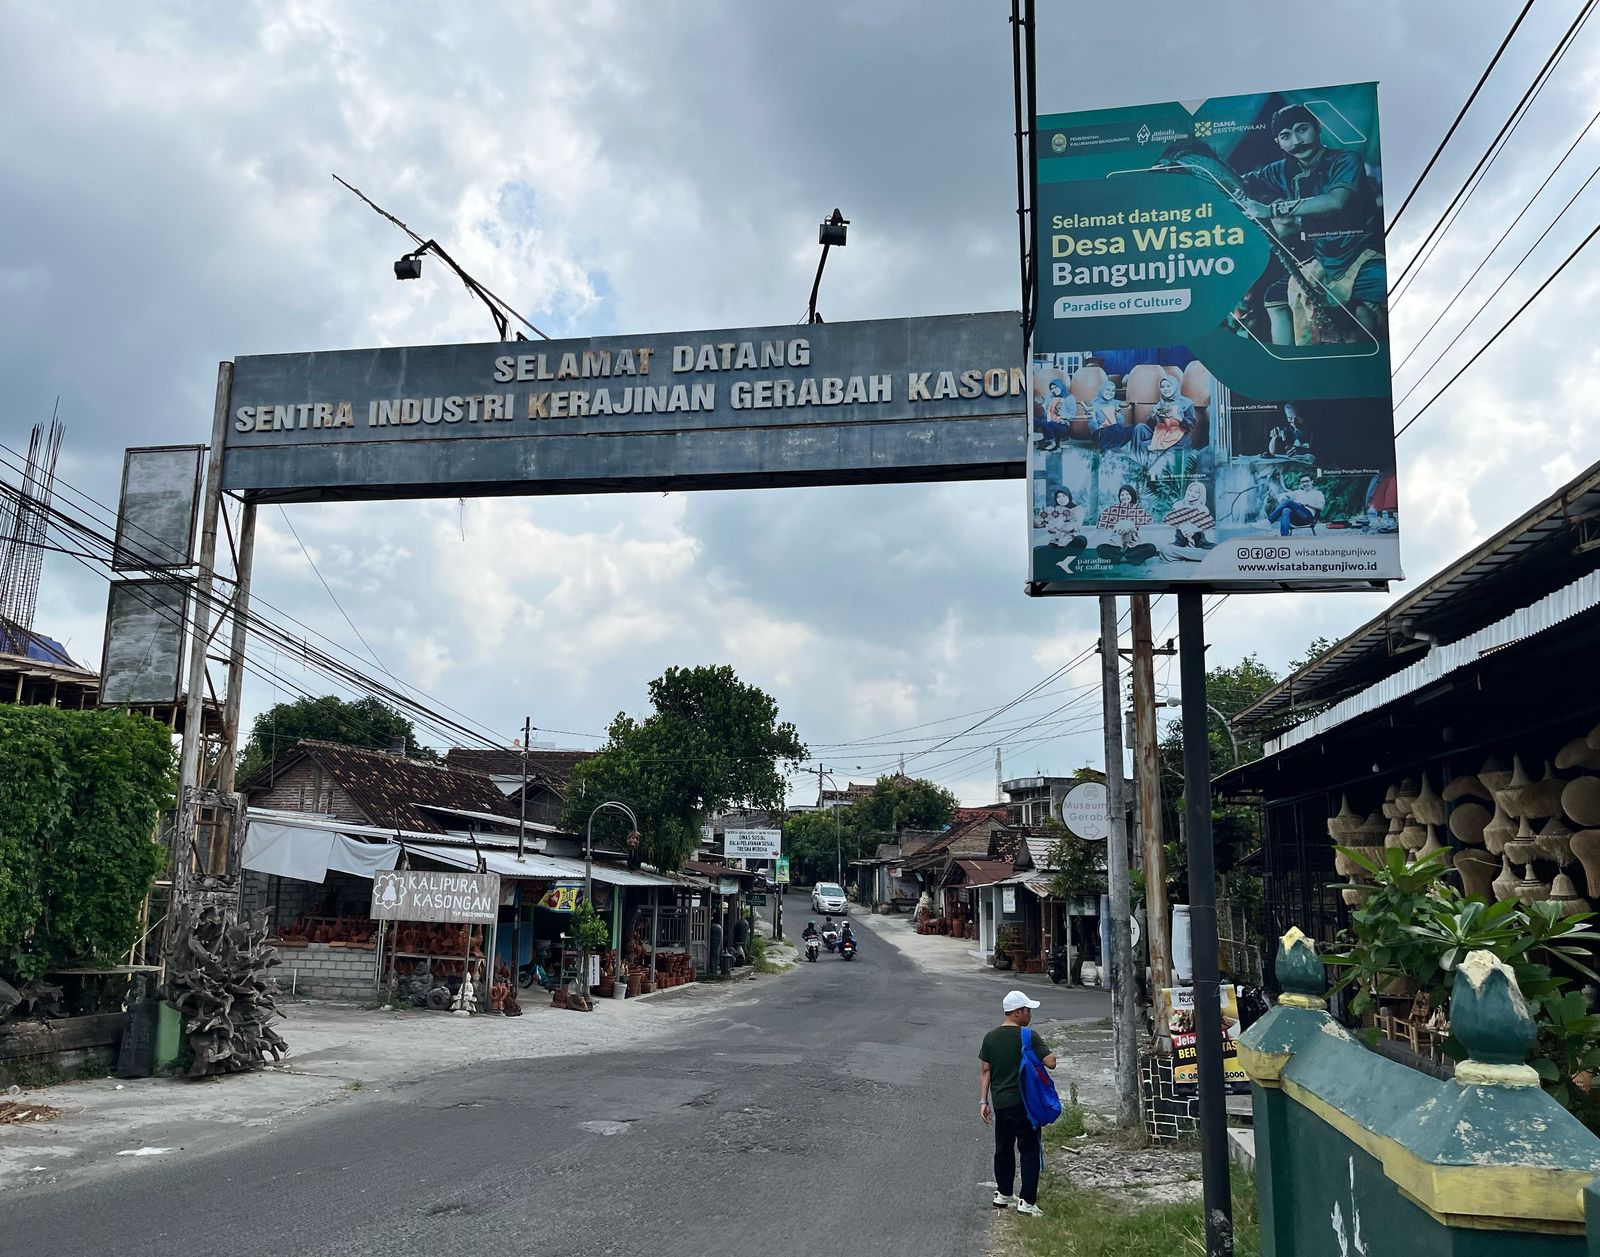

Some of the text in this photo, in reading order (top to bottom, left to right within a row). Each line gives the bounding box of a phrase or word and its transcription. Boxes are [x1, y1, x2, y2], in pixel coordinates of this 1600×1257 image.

[1213, 120, 1236, 128] DANA
[1213, 124, 1266, 134] KEISTIMEWAAN
[1052, 203, 1213, 229] Selamat datang di
[1052, 224, 1244, 258] Desa Wisata
[1052, 253, 1234, 287] Bangunjiwo
[1063, 296, 1182, 312] Paradise of Culture
[494, 338, 811, 382] SELAMAT DATANG
[235, 400, 355, 432] SENTRA
[368, 394, 515, 427] INDUSTRI
[527, 383, 716, 420] KERAJINAN
[730, 374, 892, 410] GERABAH
[1294, 548, 1376, 558] wisatabangunjiwo
[1238, 562, 1377, 572] www.wisatabangunjiwo.id
[408, 876, 478, 894] KALIPURA
[413, 894, 491, 911] KASONGAN
